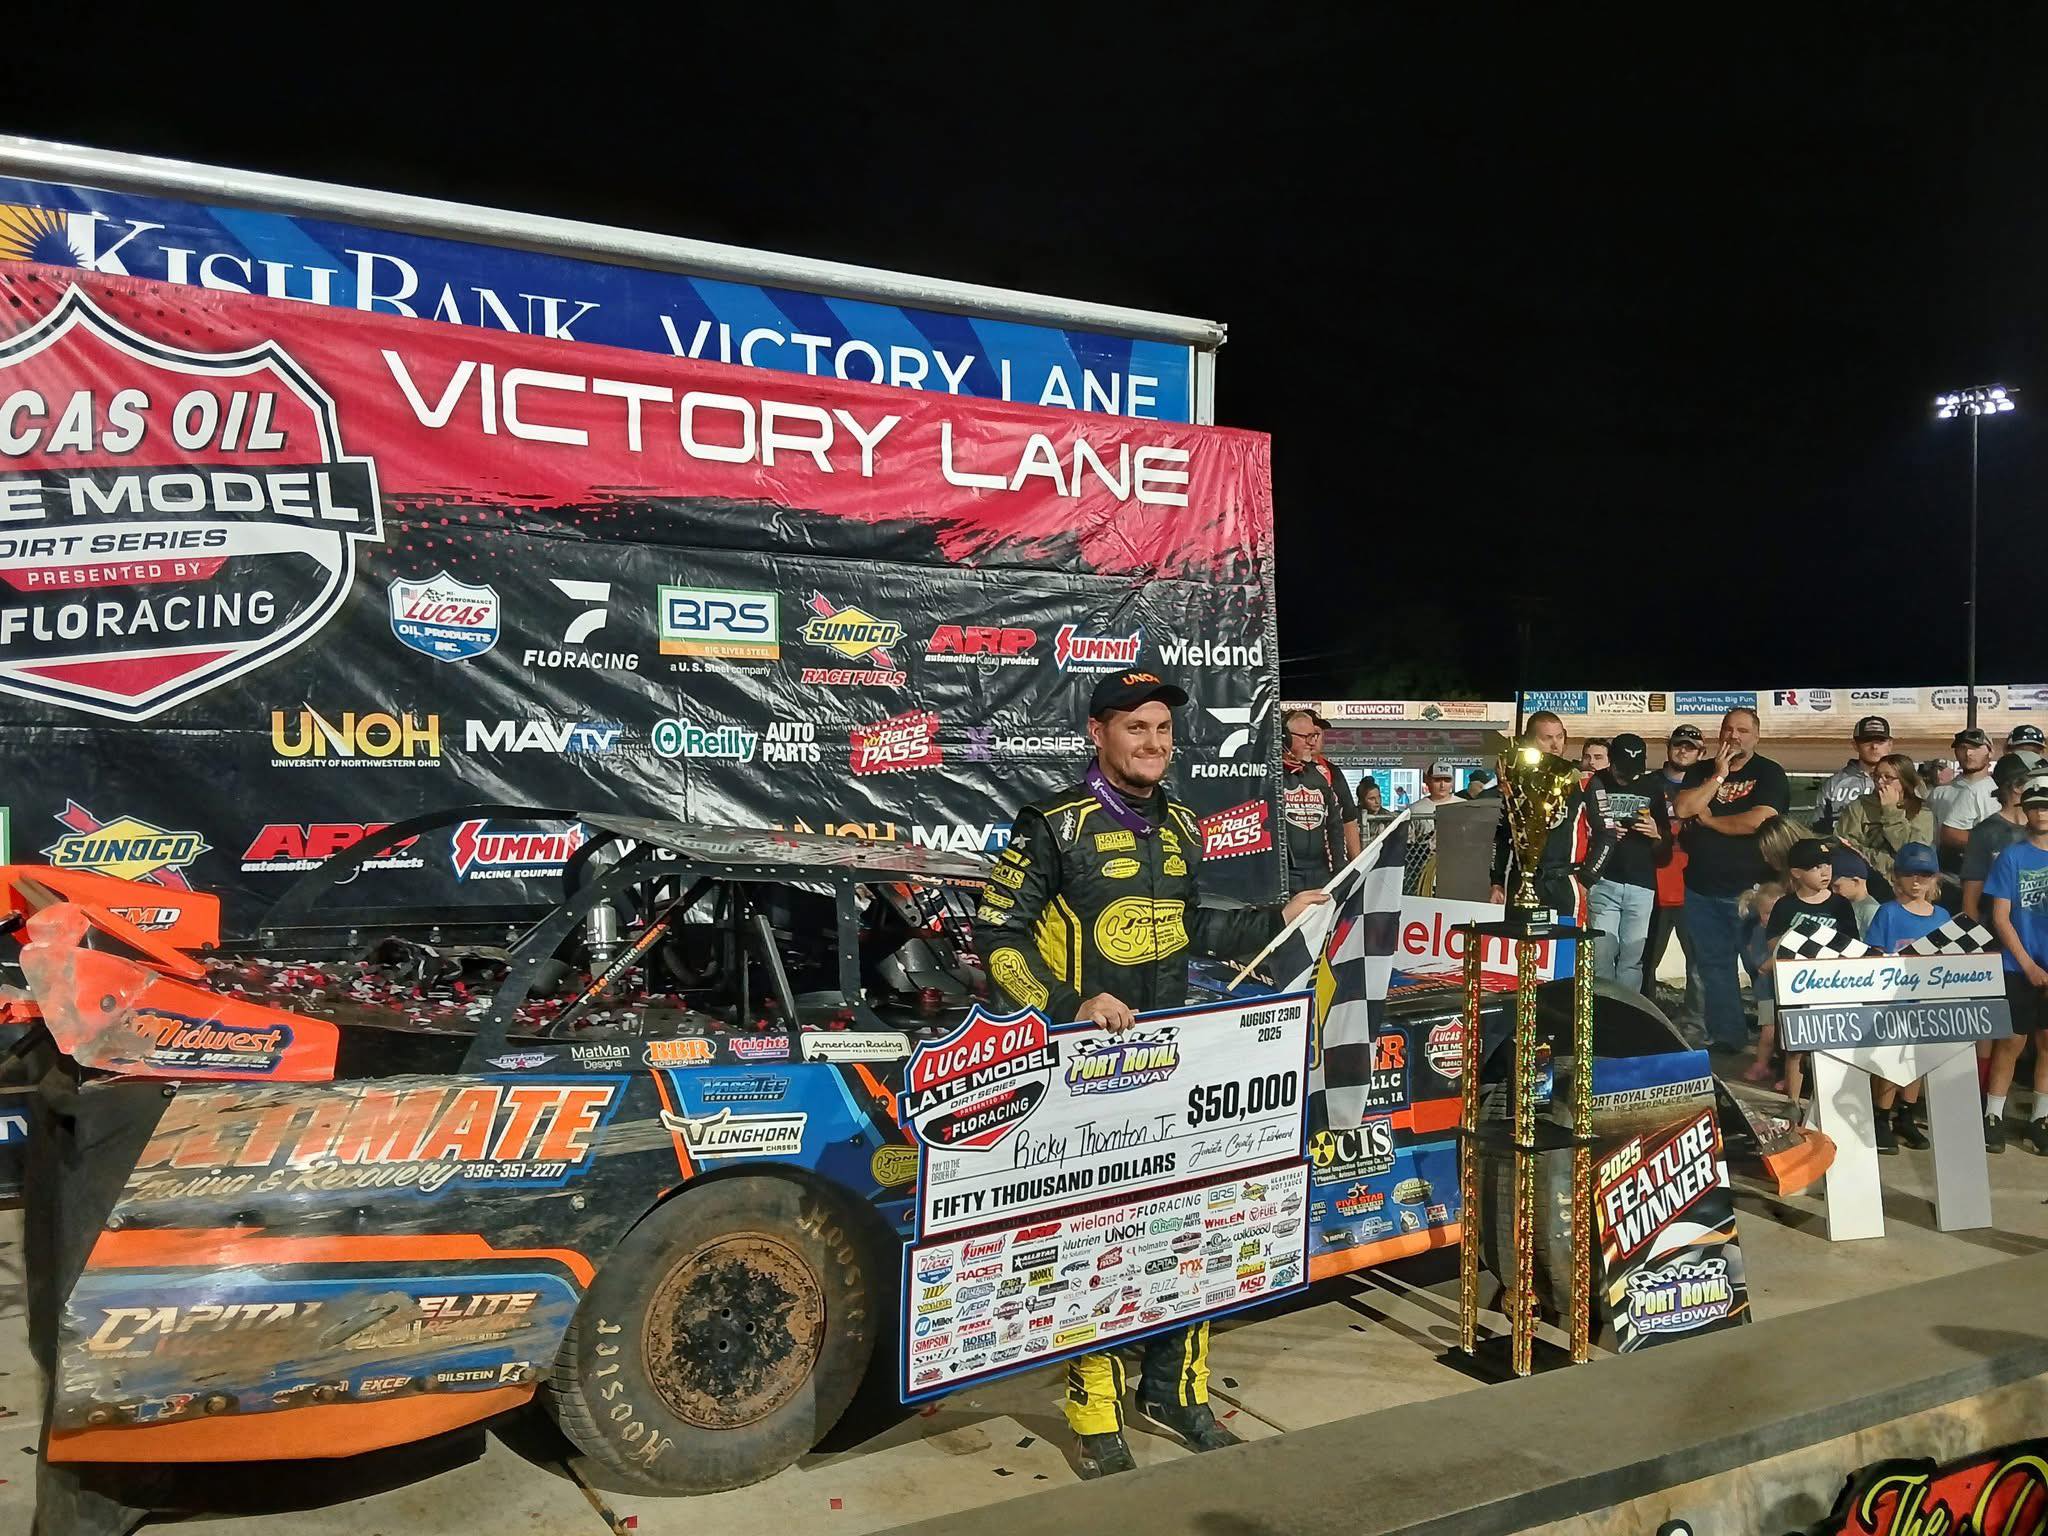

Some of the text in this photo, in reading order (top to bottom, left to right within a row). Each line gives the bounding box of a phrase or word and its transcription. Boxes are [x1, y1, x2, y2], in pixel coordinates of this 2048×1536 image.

[659, 315, 1159, 420] VICTORY LANE
[171, 390, 289, 452] OIL
[381, 349, 1190, 507] VICTORY LANE
[68, 472, 361, 523] MODEL
[90, 528, 229, 555] SERIES
[28, 561, 201, 586] PRESENTED BY
[1, 590, 276, 645] FLORACING
[403, 600, 491, 626] LUCAS
[669, 598, 770, 634] BRS
[398, 624, 492, 643] OIL PRODUCTS
[808, 621, 896, 645] SUNOCO
[925, 624, 1038, 656] ARP
[523, 649, 640, 671] FLORACING
[704, 646, 770, 656] BIG RIVER STEEL
[924, 653, 1040, 667] automotive products
[1158, 639, 1264, 667] wieland
[704, 663, 730, 674] Steel
[731, 666, 771, 677] company
[800, 667, 907, 688] RACE FUELS
[1066, 665, 1095, 674] RACING
[1533, 692, 1646, 707] PARADISE WATKINS
[1537, 699, 1579, 707] STREAM
[1676, 695, 1696, 703] Small
[1850, 690, 1890, 700] CASE
[1936, 697, 1958, 705] TIRE
[1347, 704, 1403, 715] KENWORTH
[271, 700, 441, 758] UNOH
[465, 719, 622, 753] MAVTV
[766, 721, 815, 742] AUTO
[653, 718, 758, 763] O'Reilly
[995, 735, 1086, 751] HOOSIER
[762, 742, 821, 762] PARTS
[860, 737, 930, 768] PASS
[271, 759, 441, 768] UNIVERSITY OF NORTHWESTERN OHIO
[1191, 763, 1269, 779] FLORACING
[62, 836, 191, 863] SUNOCO
[1205, 828, 1262, 852] PASS
[361, 857, 424, 871] products
[469, 869, 512, 880] RACING
[1000, 865, 1025, 884] CIS
[1119, 911, 1183, 931] JONES
[1790, 966, 1995, 993] Checkered Flag Sponsor
[1239, 1005, 1302, 1029] AUGUST 23RD
[1785, 1006, 1993, 1046] LAUVER'S CONCESSIONS
[135, 1014, 283, 1053] Midwest
[1257, 1027, 1283, 1042] 2025
[1434, 1032, 1461, 1042] LUCAS
[571, 1044, 631, 1059] MatMan
[646, 1039, 714, 1063] BBR
[812, 1040, 903, 1052] American Racing
[923, 1023, 1035, 1083] LUCAS OIL
[1427, 1043, 1449, 1054] LATE
[198, 1053, 271, 1064] METAL
[583, 1059, 623, 1070] Designs
[1069, 1042, 1179, 1082] PORT ROYAL
[904, 1048, 1056, 1118] LATE MODEL
[1070, 1069, 1174, 1097] SPEEDWAY
[1370, 1073, 1401, 1090] LLC
[1613, 1078, 1710, 1105] ROYAL SPEEDWAY
[950, 1079, 1017, 1109] DIRT SERIES
[1186, 1070, 1298, 1129] $50,000
[1390, 1091, 1404, 1103] IA
[952, 1097, 1030, 1138] FLORACING
[708, 1126, 801, 1145] LONGHORN
[1013, 1129, 1067, 1170] Ricky
[1154, 1113, 1177, 1142] Jr.
[1336, 1119, 1392, 1162] CIS
[931, 1158, 961, 1173] PAY TO THE
[1600, 1137, 1642, 1187] 2025
[1604, 1115, 1715, 1227] FEATURE
[286, 1158, 465, 1193] Recovery
[463, 1162, 567, 1180] 336-351-2277
[932, 1189, 992, 1221] FIFTY
[991, 1169, 1094, 1206] THOUSAND
[1096, 1152, 1177, 1186] DOLLARS
[1210, 1187, 1235, 1202] BRS
[1335, 1199, 1358, 1209] FIVE
[1615, 1151, 1714, 1254] WINNER
[1069, 1208, 1125, 1234] wieland
[1136, 1194, 1202, 1219] FLORACING
[1183, 1218, 1202, 1229] PARTS
[1184, 1211, 1201, 1221] AUTO
[1203, 1206, 1278, 1230] WHELEN FUEL
[1062, 1234, 1101, 1252] Nutrien
[1104, 1221, 1147, 1244] UNOH
[1020, 1248, 1057, 1261] ALLSTAR
[1137, 1240, 1169, 1252] holmatro
[955, 1263, 1004, 1283] RACER
[1238, 1275, 1267, 1293] MSD
[417, 1293, 538, 1319] ELITE
[1633, 1276, 1728, 1317] PORT ROYAL
[1028, 1314, 1054, 1329] PEM
[1638, 1303, 1728, 1332] SPEEDWAY
[914, 1334, 950, 1353] SIMPSON
[437, 1370, 495, 1383] BILSTEIN
